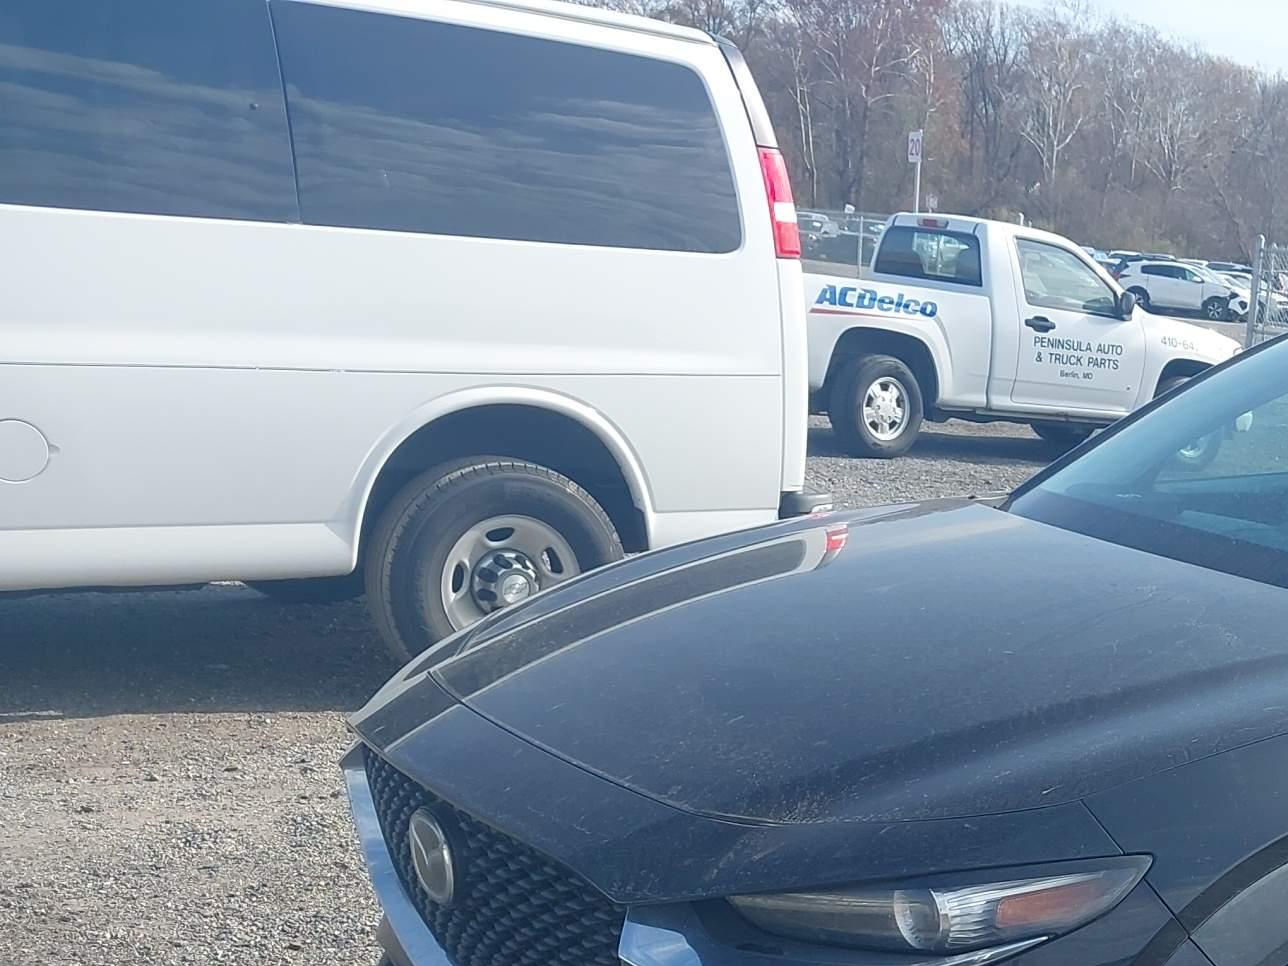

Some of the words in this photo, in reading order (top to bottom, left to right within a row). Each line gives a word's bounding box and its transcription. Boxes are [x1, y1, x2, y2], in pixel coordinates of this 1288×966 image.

[909, 138, 921, 156] 20
[815, 284, 938, 318] ACDelco
[1033, 336, 1092, 353] PENINSULA
[1096, 344, 1123, 356] AUTO
[1035, 353, 1043, 363] &
[1049, 352, 1083, 367] TRUCK
[1087, 357, 1120, 370] PARTS
